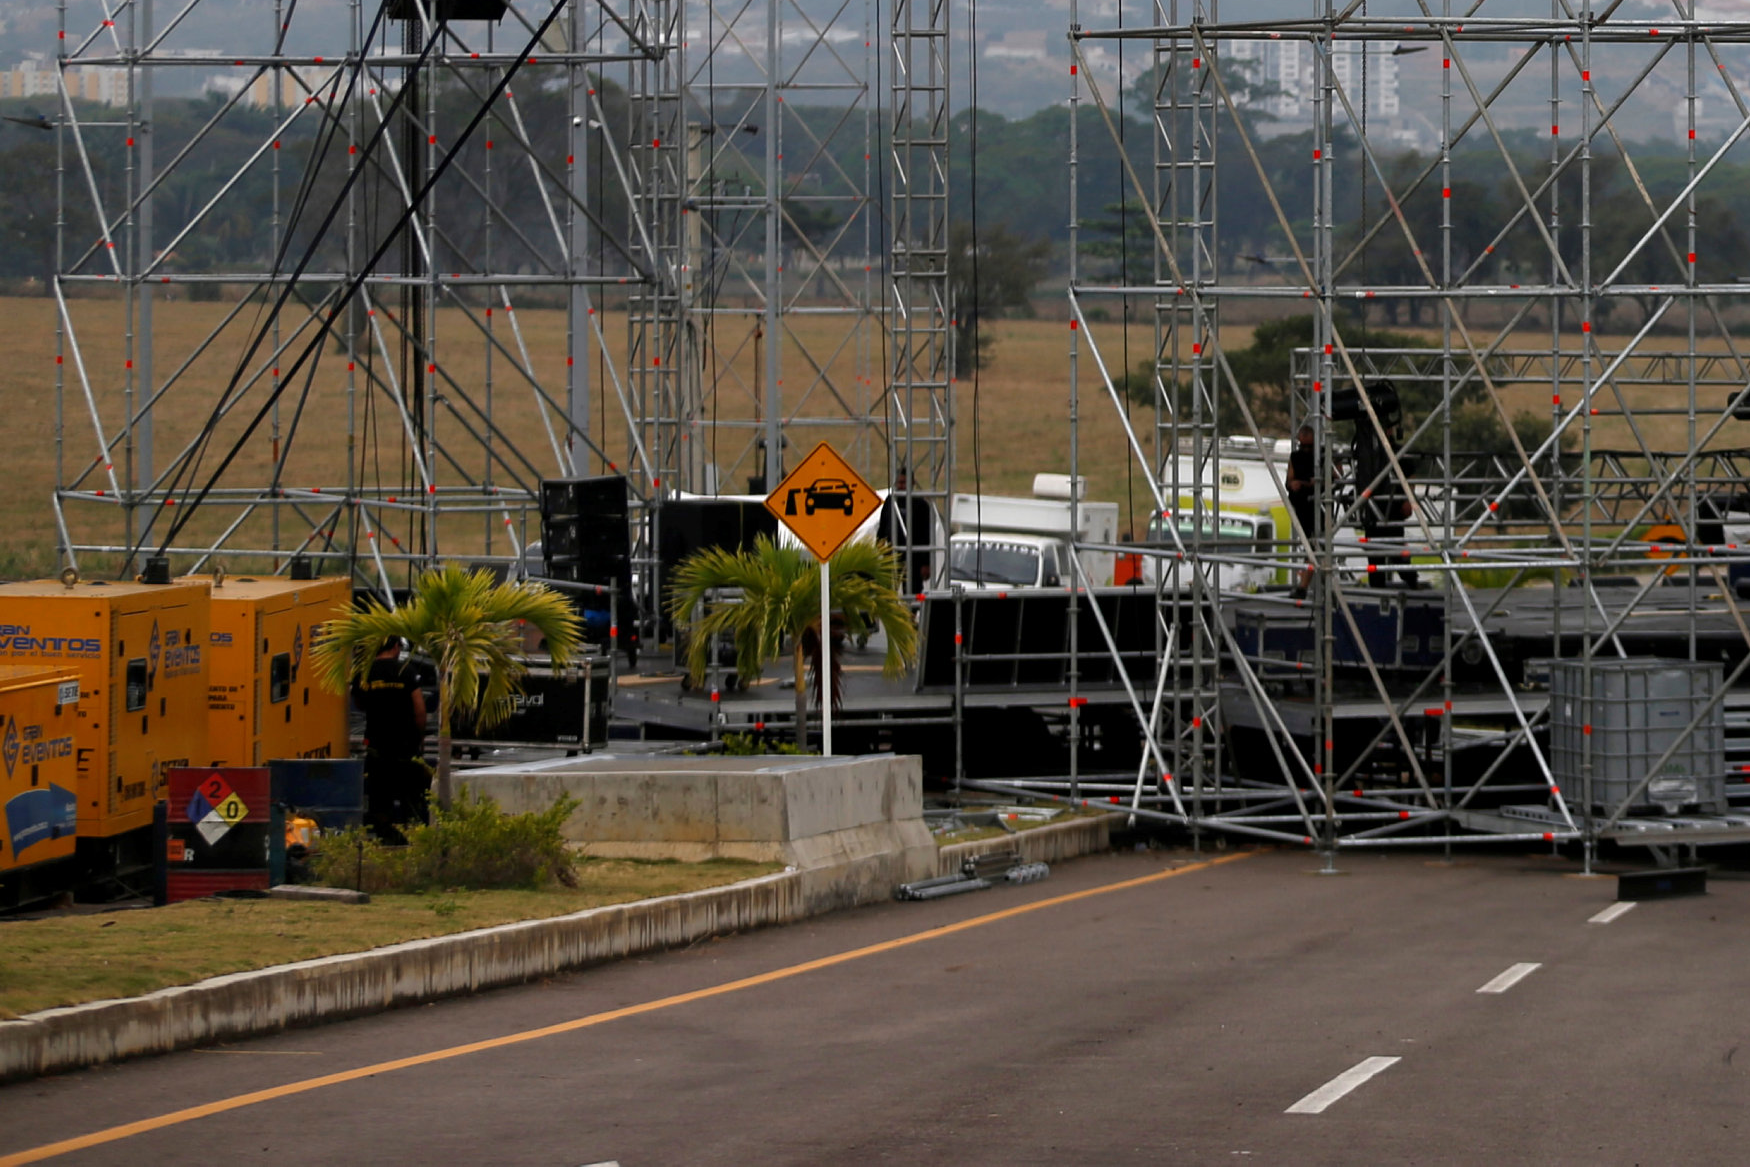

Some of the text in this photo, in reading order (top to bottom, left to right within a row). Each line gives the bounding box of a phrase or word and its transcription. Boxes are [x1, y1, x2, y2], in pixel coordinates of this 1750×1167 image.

[209, 781, 222, 799] 2
[226, 801, 239, 820] 0
[184, 848, 195, 861] R
